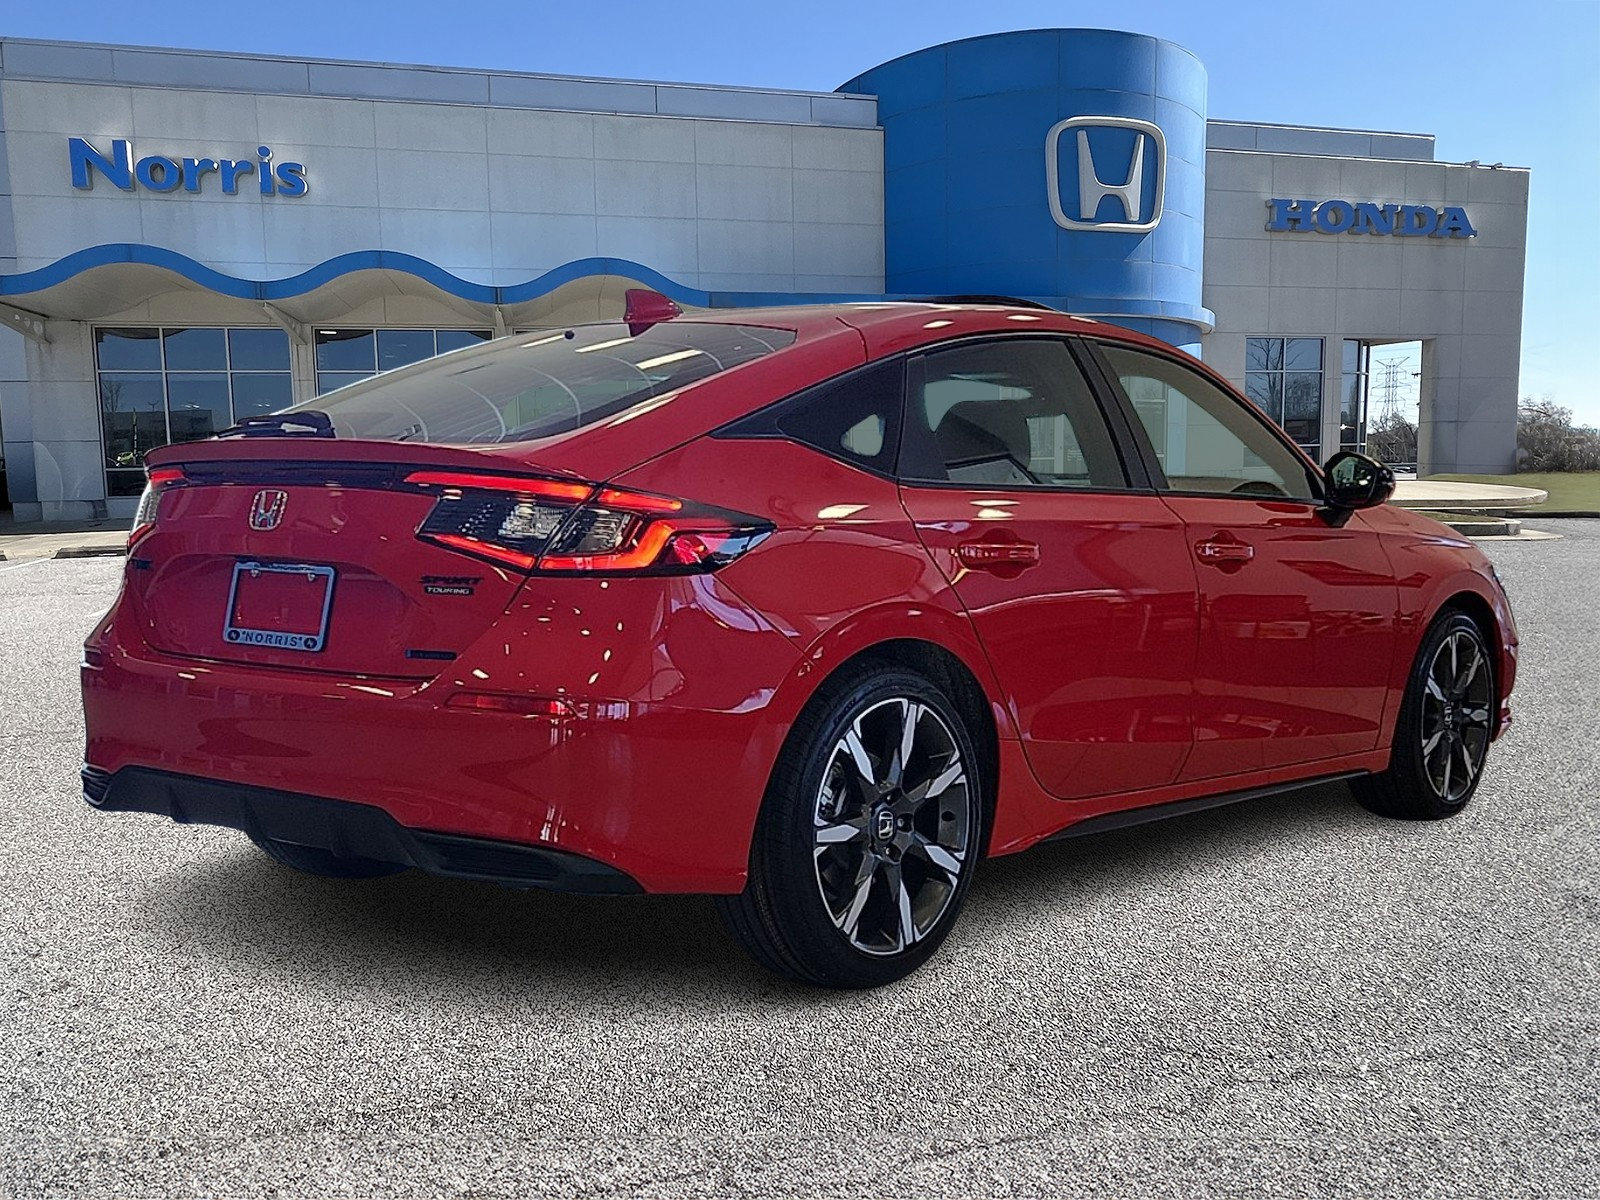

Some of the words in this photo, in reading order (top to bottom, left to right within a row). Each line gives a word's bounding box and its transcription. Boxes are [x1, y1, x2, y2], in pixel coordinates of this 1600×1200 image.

[68, 137, 309, 197] Norris
[1266, 198, 1478, 239] HONDA
[426, 586, 470, 595] TOURING
